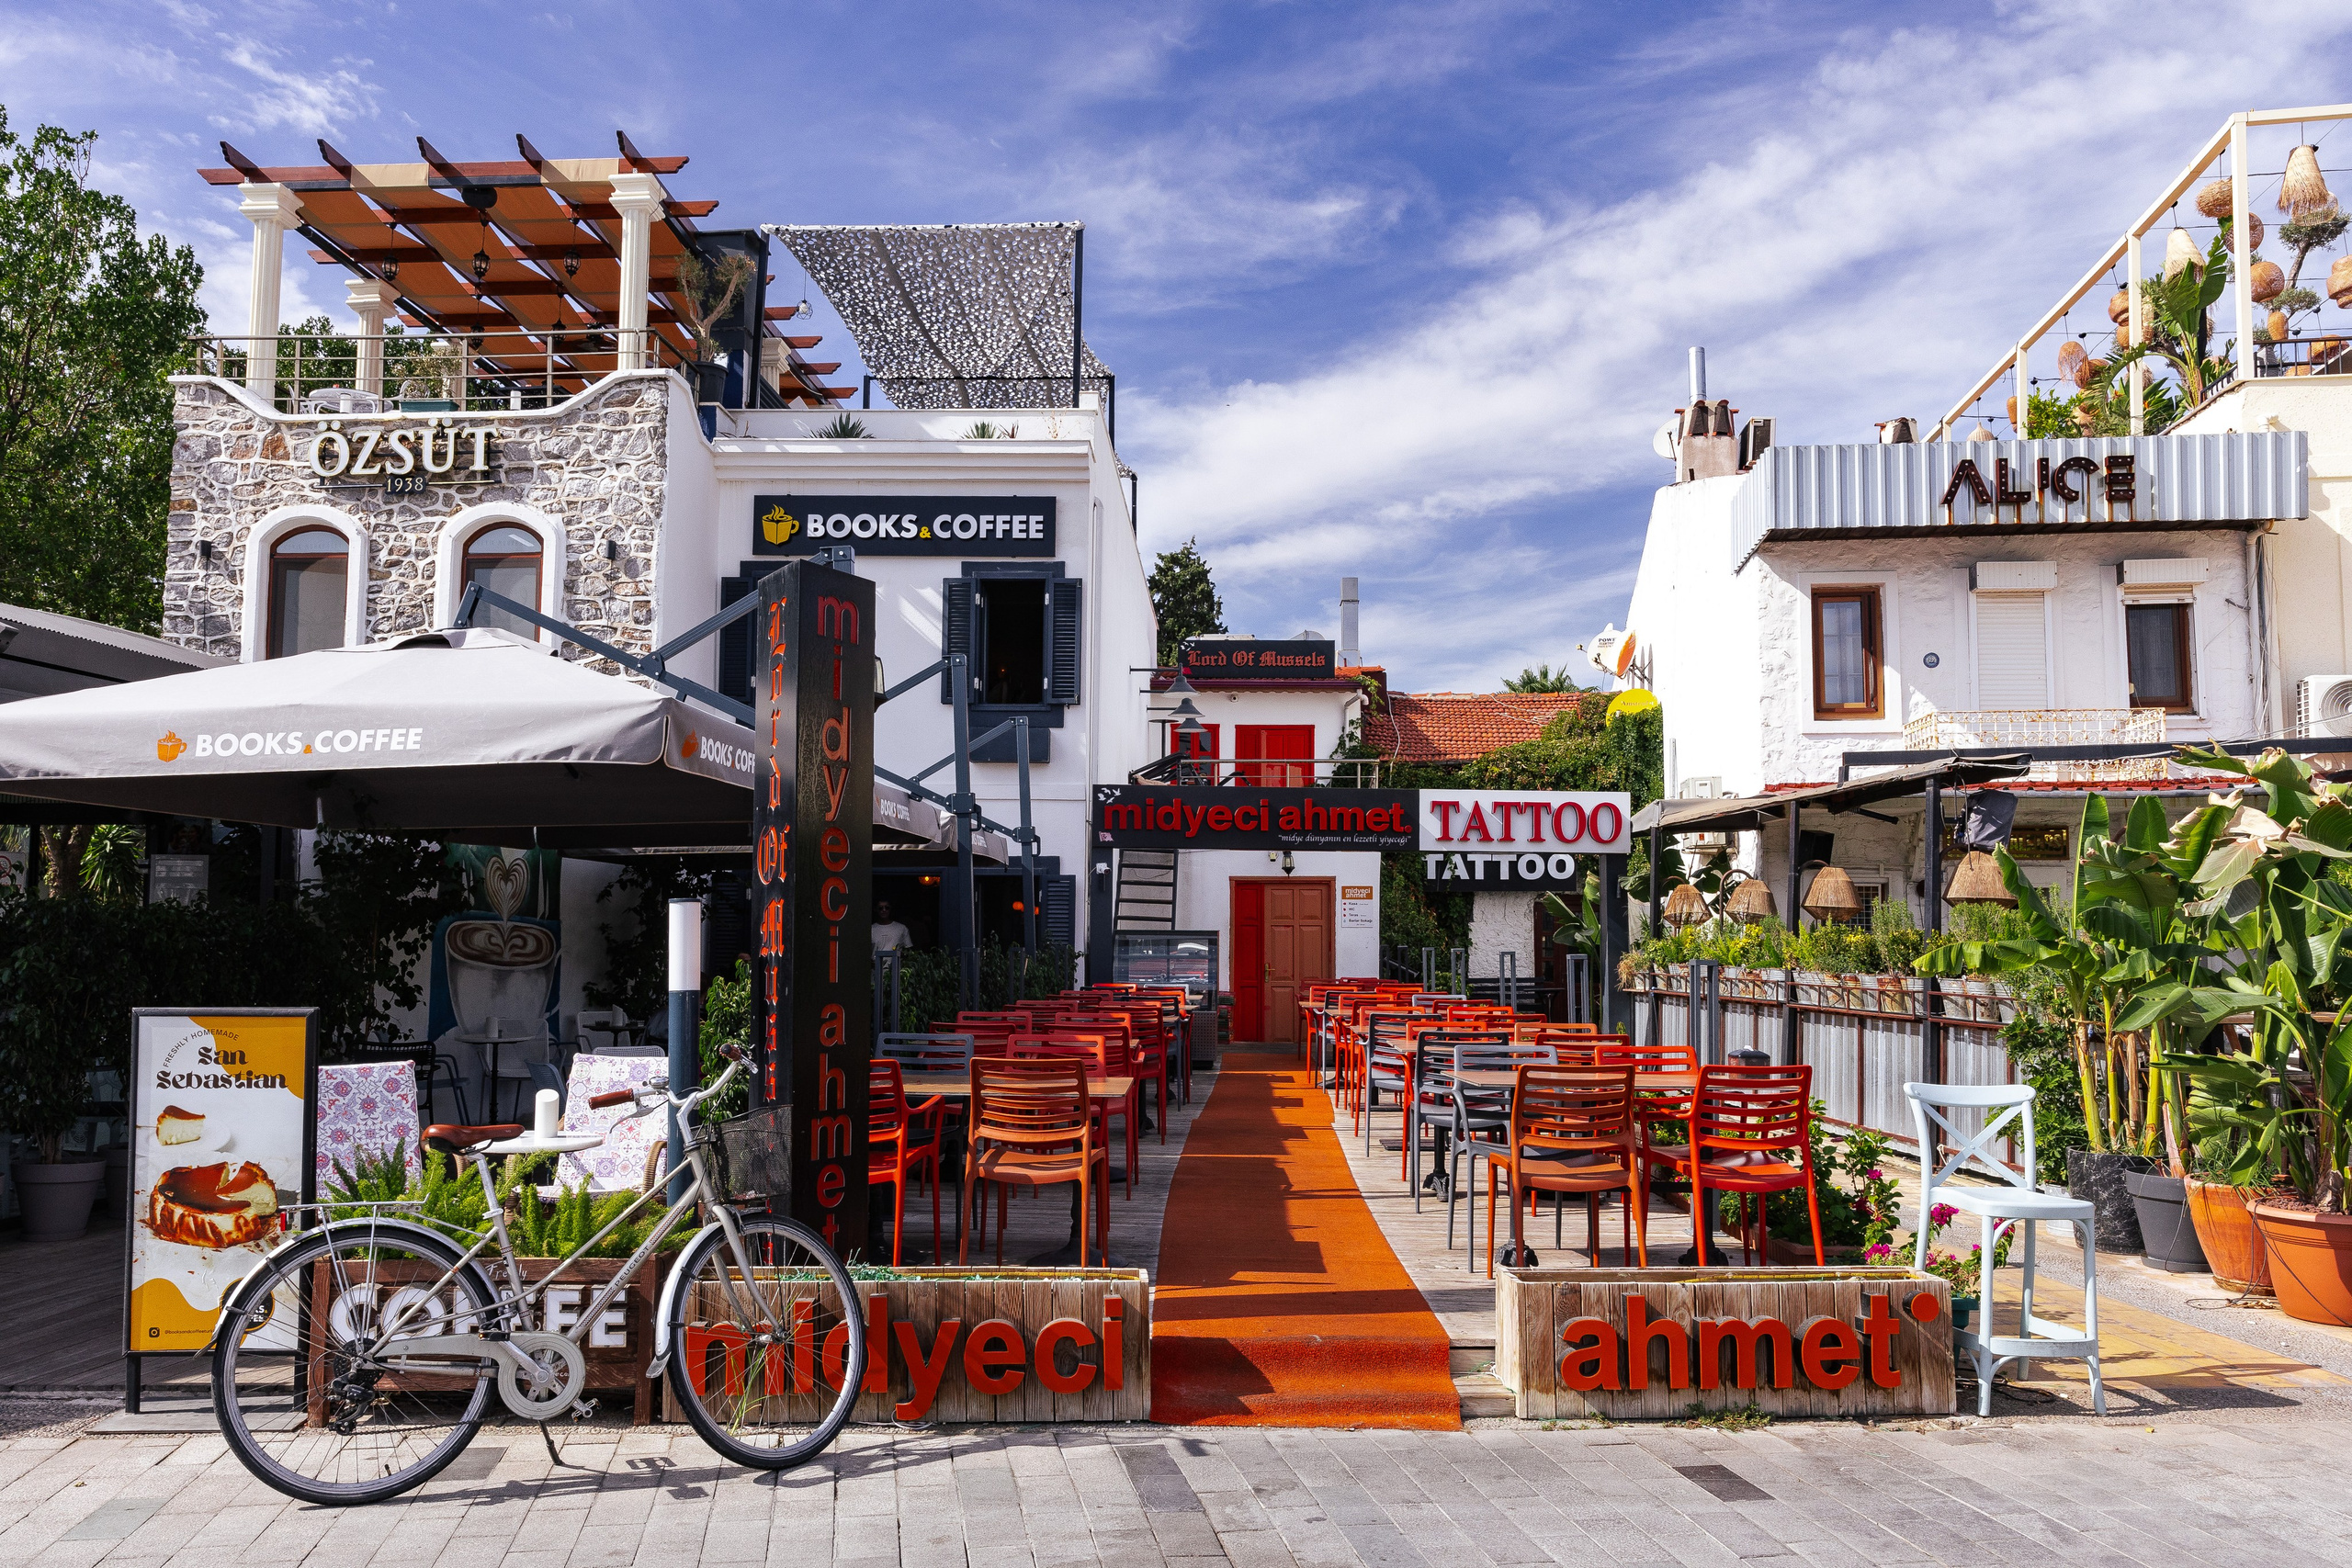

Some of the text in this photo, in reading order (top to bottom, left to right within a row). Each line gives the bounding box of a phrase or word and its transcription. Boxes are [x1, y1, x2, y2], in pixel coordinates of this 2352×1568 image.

[310, 418, 499, 477] ÖZSÜT
[386, 478, 424, 492] 1938
[1940, 455, 2136, 505] ALICE
[1187, 650, 1326, 667] Lord Of Mussels
[1104, 797, 1270, 838] midyeci
[1429, 799, 1624, 844] TATTOO
[1353, 833, 1377, 843] lezzetli
[1425, 852, 1575, 880] TATTOO
[163, 1028, 240, 1068] FRESHLY HOMEMADE
[198, 1045, 248, 1066] San
[156, 1069, 288, 1089] Sebastian
[484, 1260, 527, 1280] Frely
[614, 1245, 650, 1287] PEUGEOT
